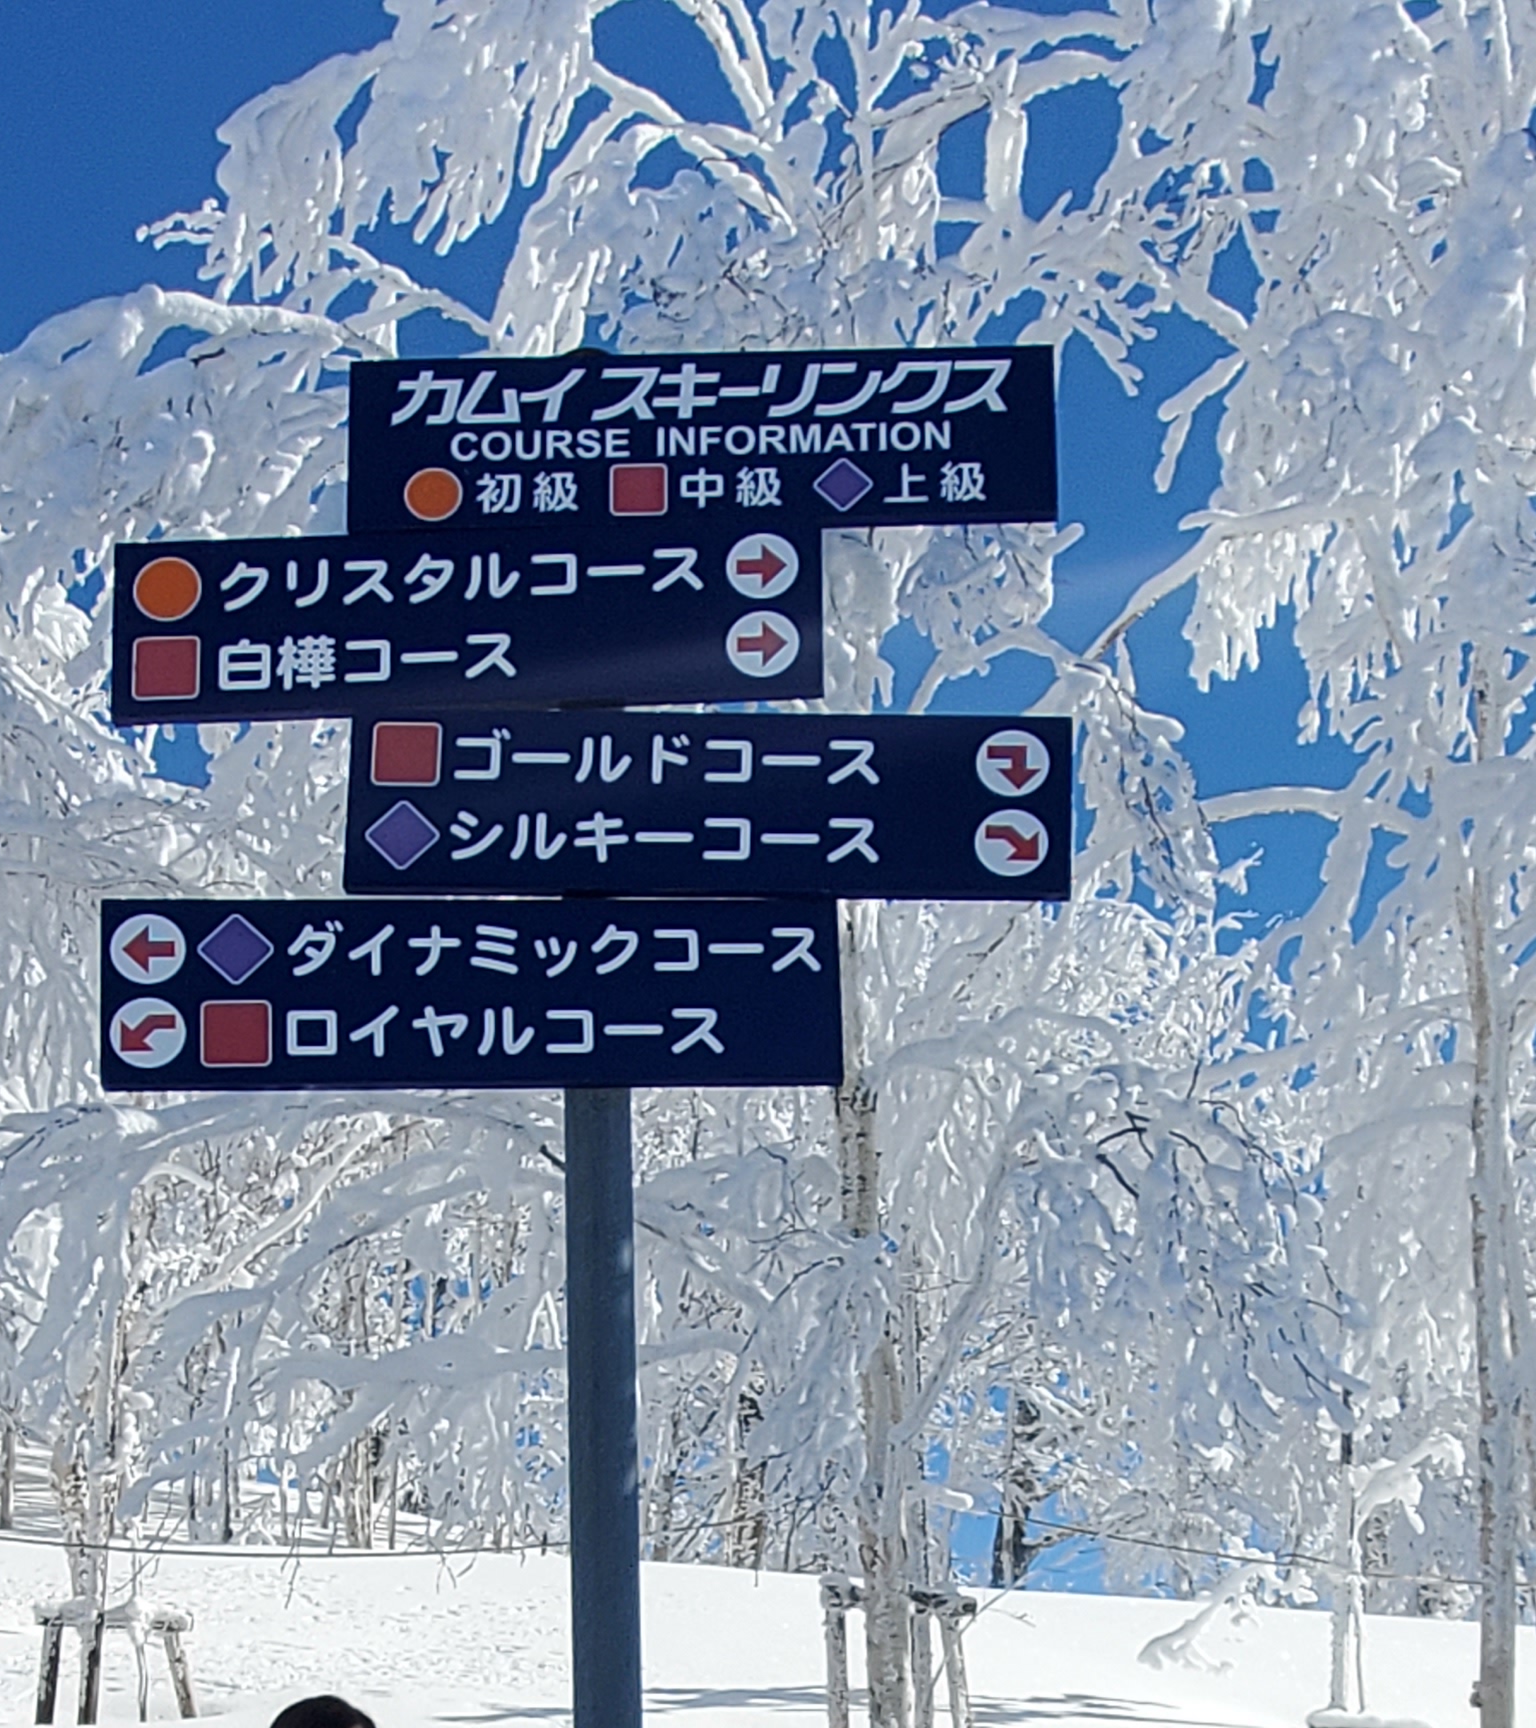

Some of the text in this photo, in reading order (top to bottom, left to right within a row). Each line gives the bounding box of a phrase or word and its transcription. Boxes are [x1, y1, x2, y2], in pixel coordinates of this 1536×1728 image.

[449, 420, 953, 462] COURSE INFORMATION
[475, 461, 988, 514] 初級 中級 上級
[219, 546, 705, 612] クリスタルコース
[217, 633, 518, 692] 白樺コース
[452, 727, 881, 785] ゴールドコース
[449, 809, 880, 864] シルキーコース
[286, 919, 823, 978] ダイナミックコース
[285, 1004, 726, 1058] ロイヤルコース
